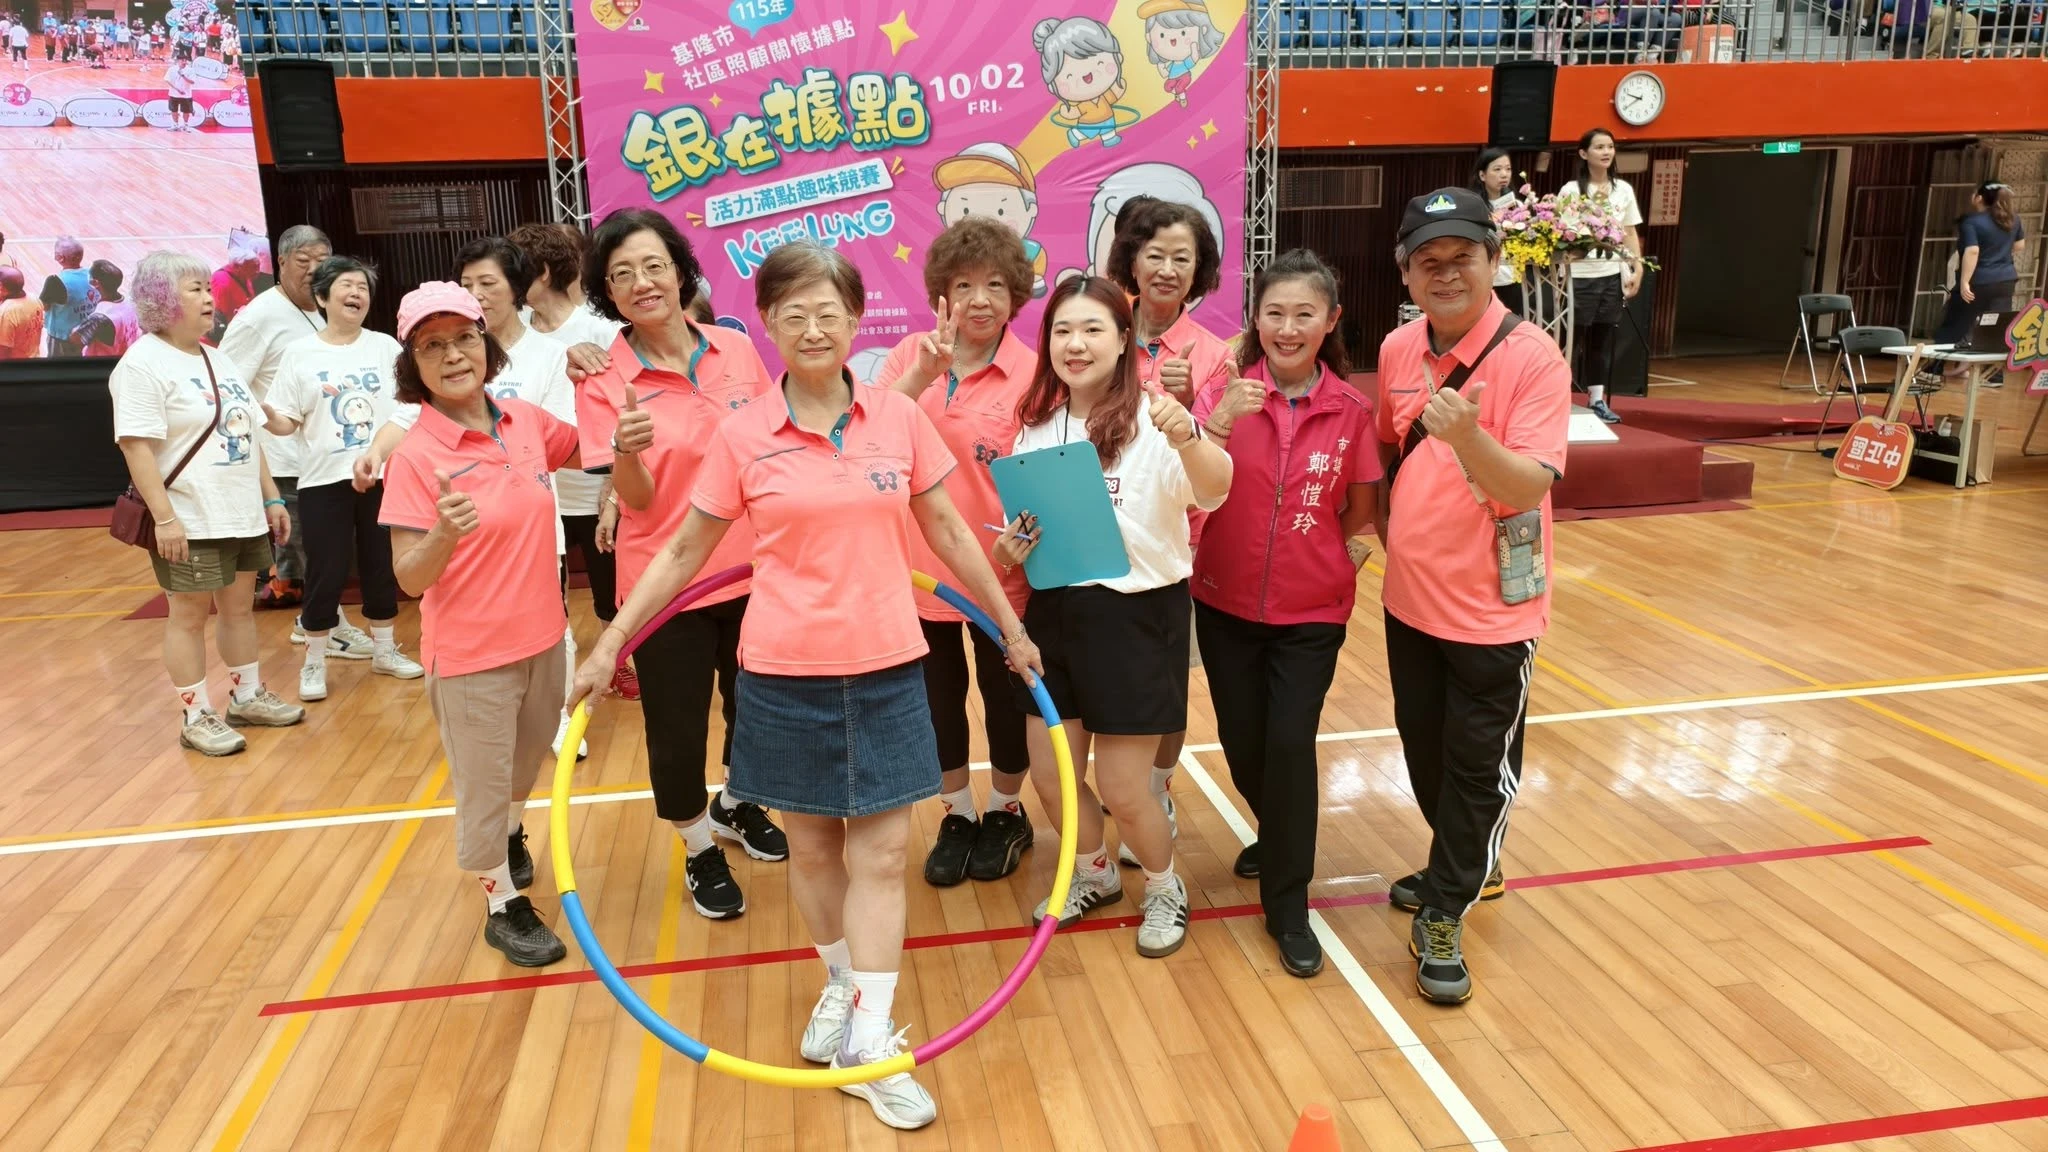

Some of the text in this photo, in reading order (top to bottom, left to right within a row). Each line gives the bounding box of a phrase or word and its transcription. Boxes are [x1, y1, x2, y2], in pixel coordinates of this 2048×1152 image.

[735, 0, 787, 20] 115年
[671, 25, 735, 67] 基隆市
[682, 16, 856, 91] 社區照顧關懷據點
[929, 63, 1025, 102] 10/02
[968, 99, 1003, 115] FRI.
[622, 69, 929, 200] 銀在據點
[711, 164, 880, 222] 活力滿點趣味競賽
[725, 201, 895, 279] KEELUNG
[1291, 450, 1330, 536] 鄭愷玲
